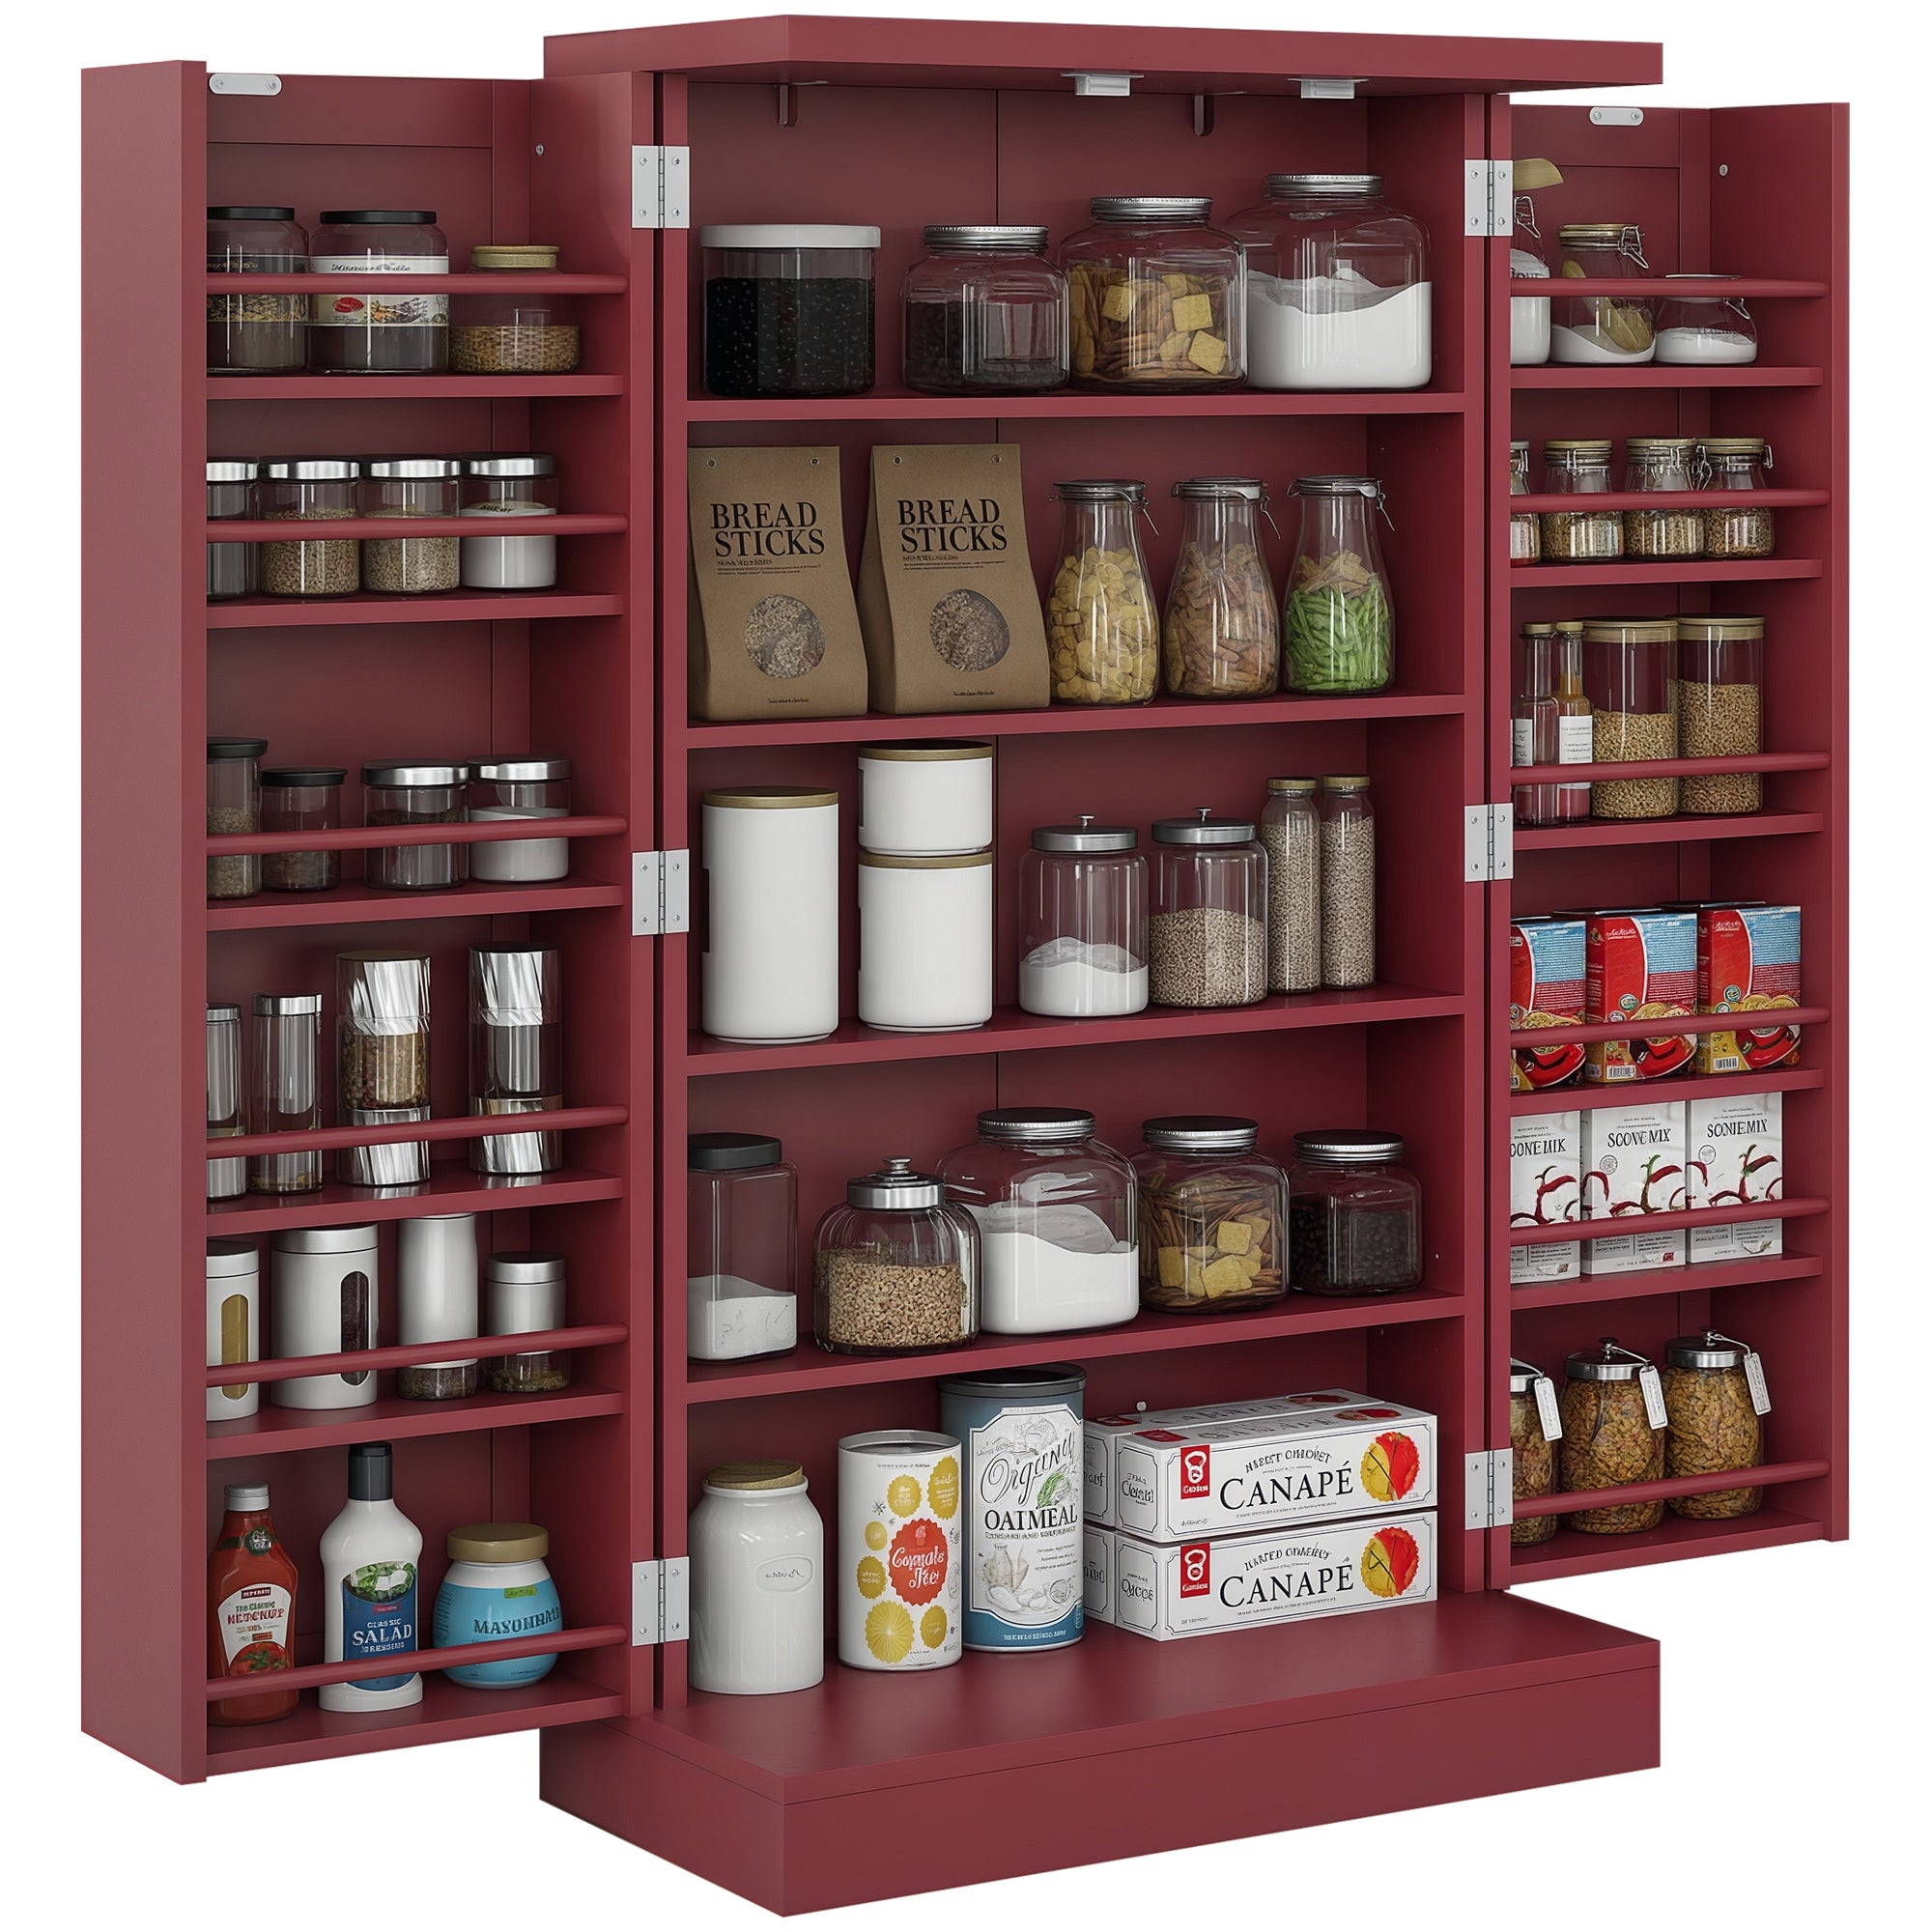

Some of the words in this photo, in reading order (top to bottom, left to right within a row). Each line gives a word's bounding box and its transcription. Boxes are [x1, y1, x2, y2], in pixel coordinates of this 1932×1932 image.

[710, 501, 817, 529] BREAD
[896, 497, 1001, 526] BREAD
[715, 528, 825, 557] STICKS
[900, 525, 1008, 554] STICKS
[1219, 1460, 1354, 1511] CANAPÉ
[1219, 1555, 1355, 1607] CANAPÉ
[352, 1624, 412, 1646] SALAD
